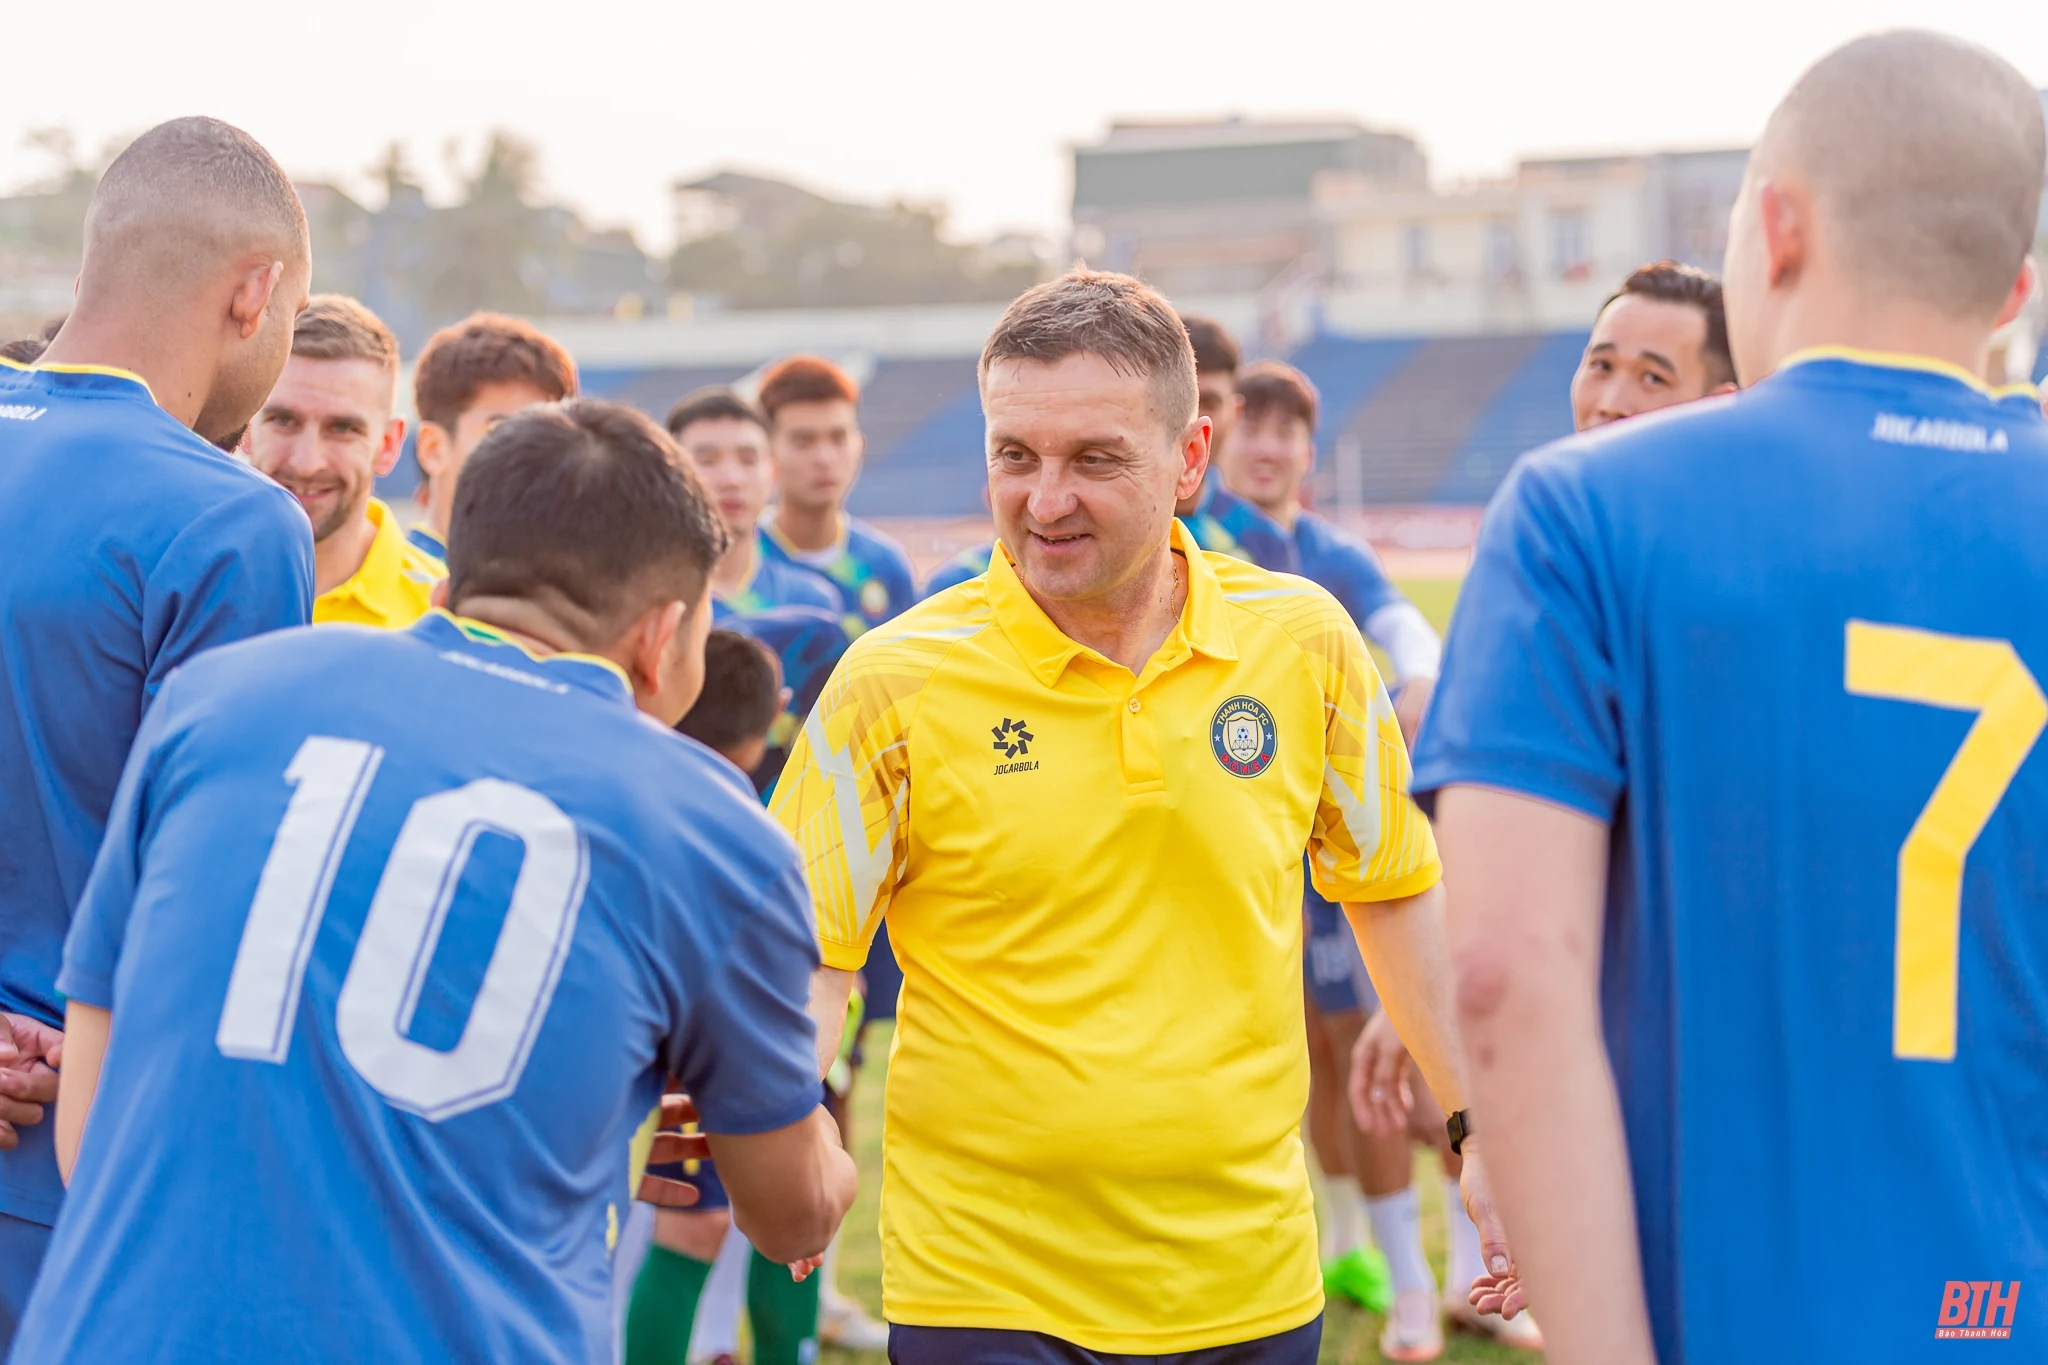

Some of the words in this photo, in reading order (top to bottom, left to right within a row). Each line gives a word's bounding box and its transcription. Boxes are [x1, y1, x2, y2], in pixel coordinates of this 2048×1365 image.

[993, 760, 1039, 775] JOGARBOLA
[1216, 701, 1240, 726] THANH
[1242, 701, 1259, 716] HÓA
[1258, 712, 1269, 726] FC
[217, 735, 592, 1121] 10
[1844, 618, 2048, 1062] 7
